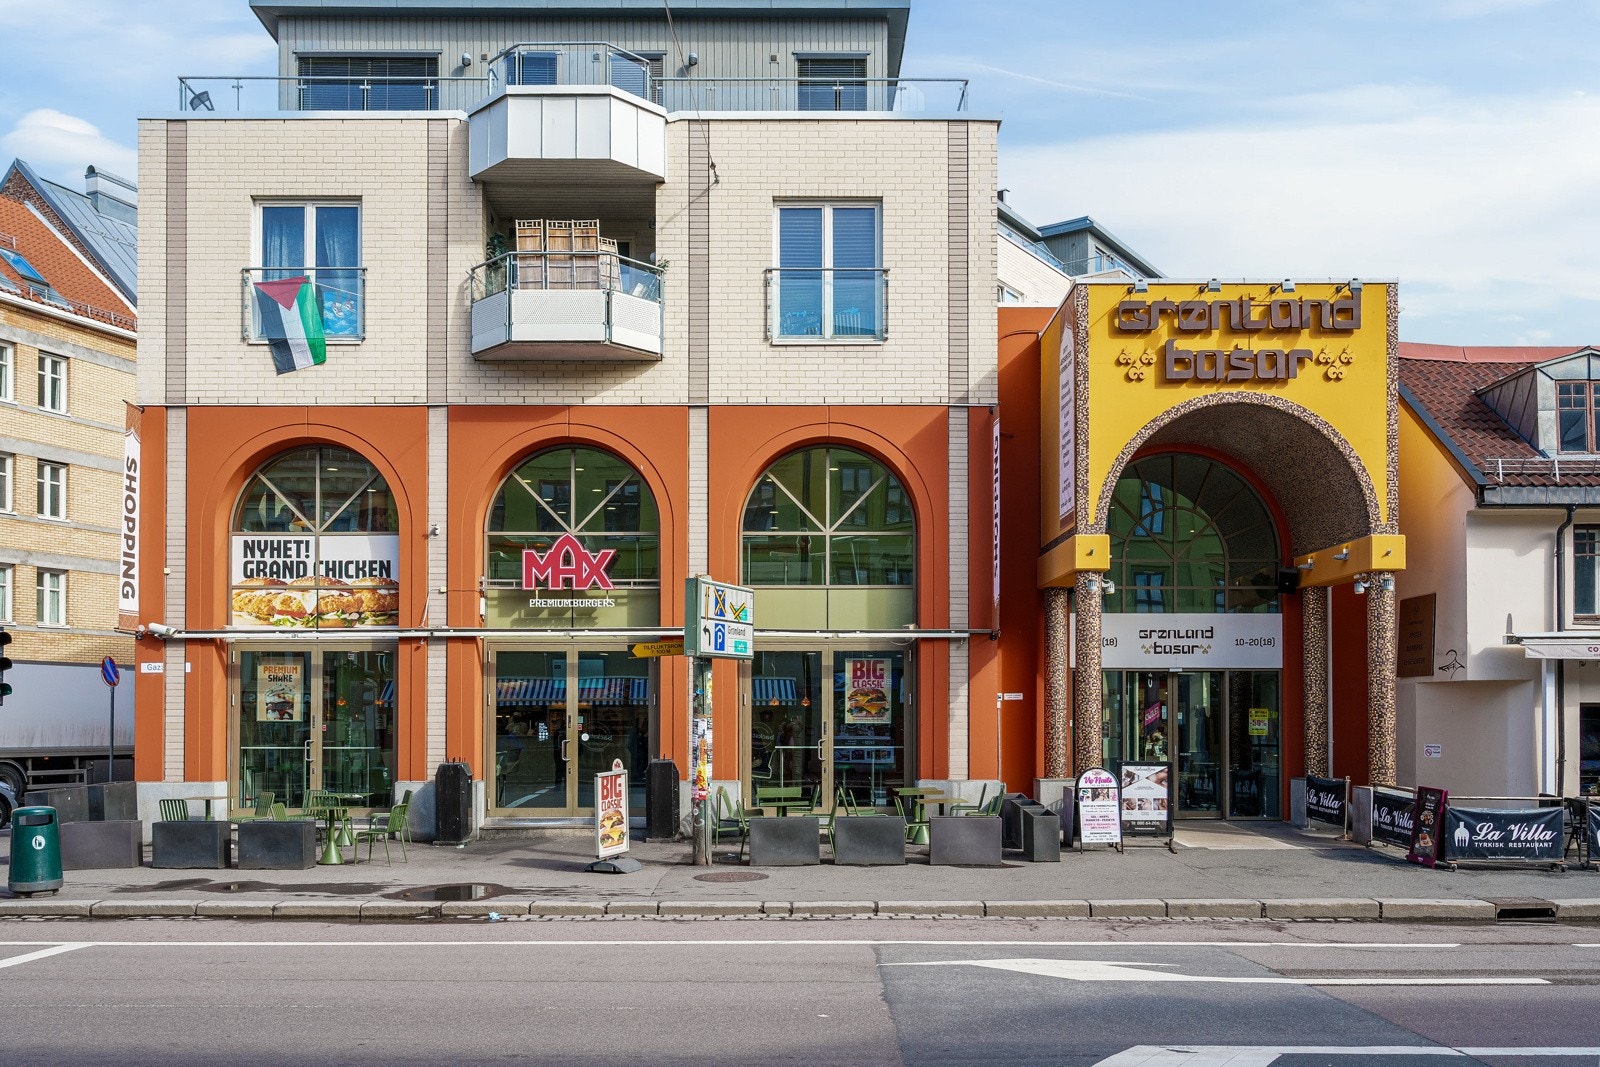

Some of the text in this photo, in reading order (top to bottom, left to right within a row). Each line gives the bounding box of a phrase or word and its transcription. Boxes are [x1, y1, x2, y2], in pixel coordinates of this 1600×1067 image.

[1165, 338, 1313, 383] basar
[122, 457, 138, 600] SHOPPING
[243, 539, 310, 559] NYHET!
[243, 560, 391, 579] GRAND CHICKEN
[522, 531, 617, 590] MAX
[529, 598, 615, 607] PREMIUM BURGERS
[263, 665, 298, 674] PREMIUM
[268, 674, 293, 683] SHAKE
[852, 660, 885, 680] BIG
[852, 680, 885, 689] CLASSIC
[601, 774, 622, 801] BIG
[601, 798, 623, 812] CLASSIC
[1319, 791, 1342, 809] Villa
[1378, 806, 1414, 829] La Villa
[1471, 822, 1557, 841] La Villa
